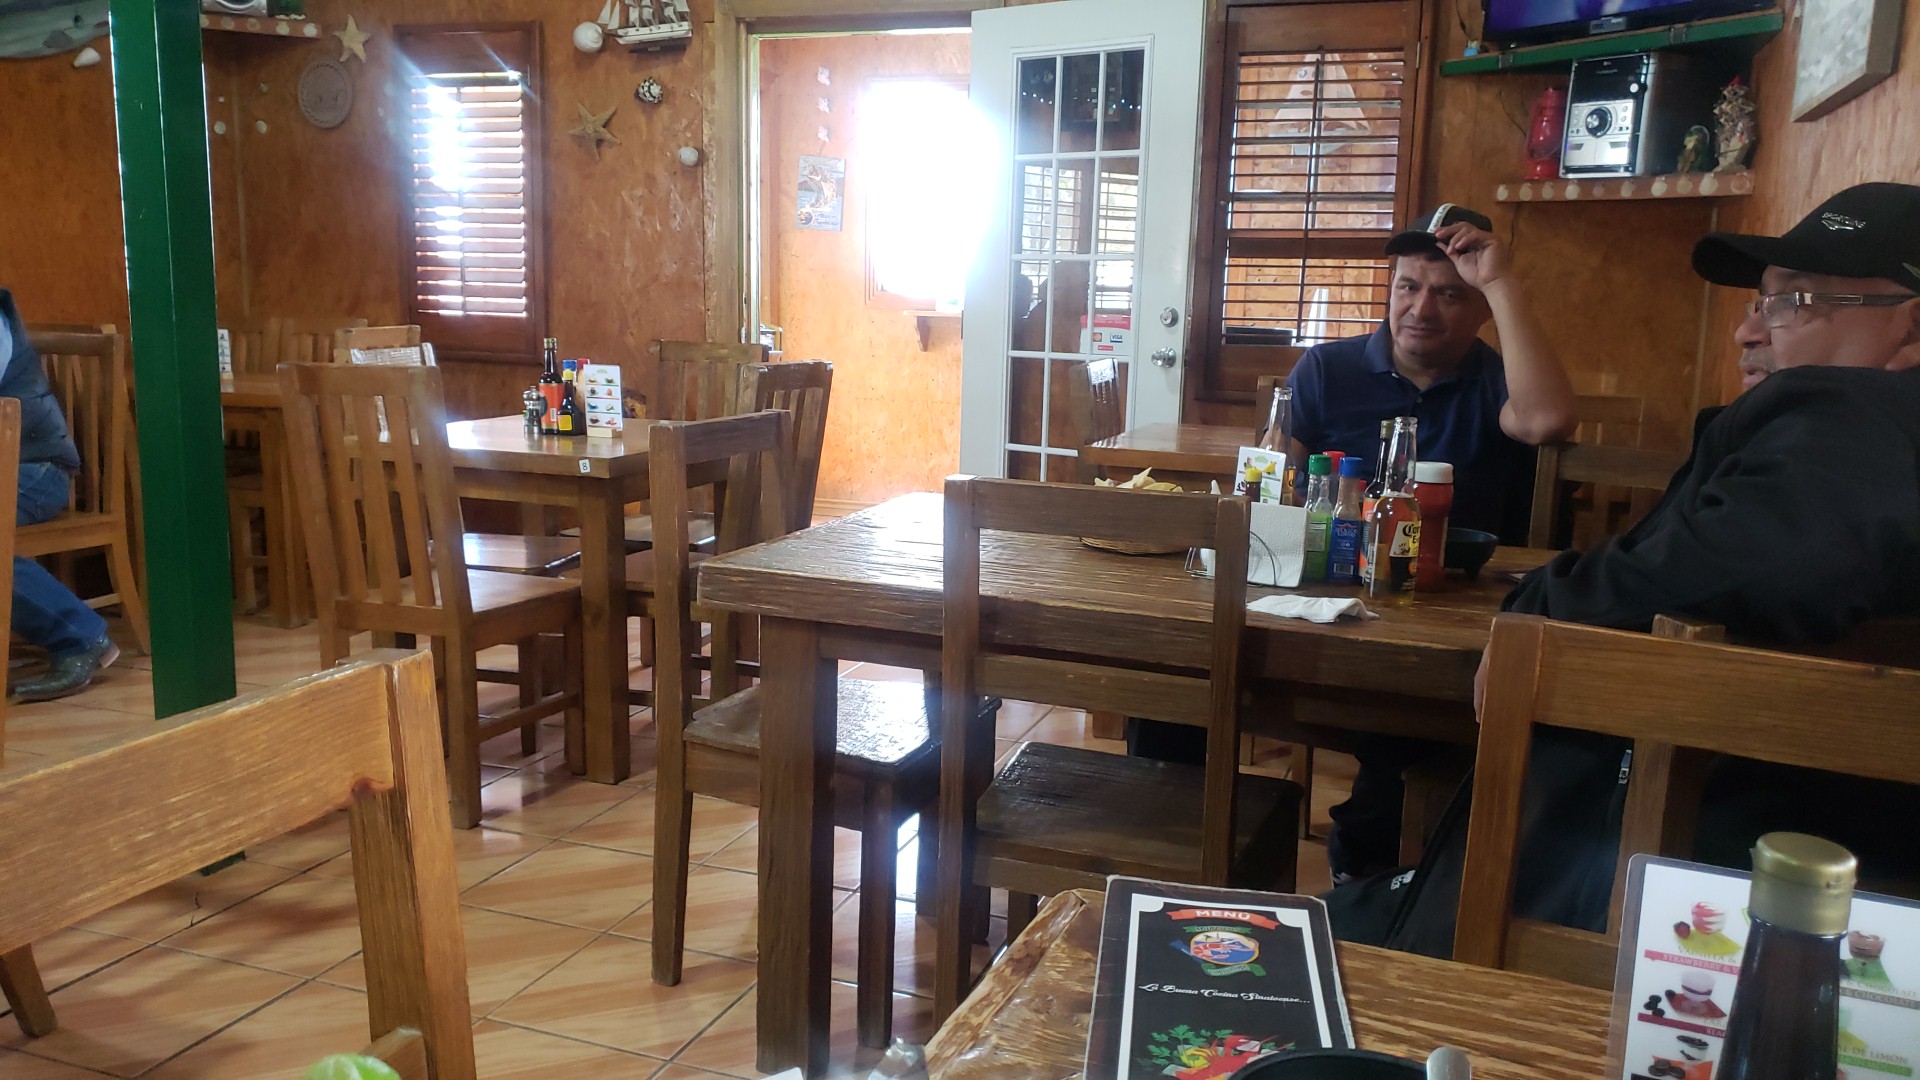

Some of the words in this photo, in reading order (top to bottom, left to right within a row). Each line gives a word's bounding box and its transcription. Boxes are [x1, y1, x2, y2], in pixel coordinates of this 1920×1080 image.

[582, 462, 588, 471] 8
[1402, 523, 1421, 537] Cor
[1662, 953, 1721, 971] STRAWBERRY
[1138, 983, 1160, 992] La
[1161, 985, 1199, 995] Buena
[1200, 989, 1239, 999] Cocina
[1852, 1047, 1866, 1057] DE
[1869, 1050, 1909, 1064] LIMON
